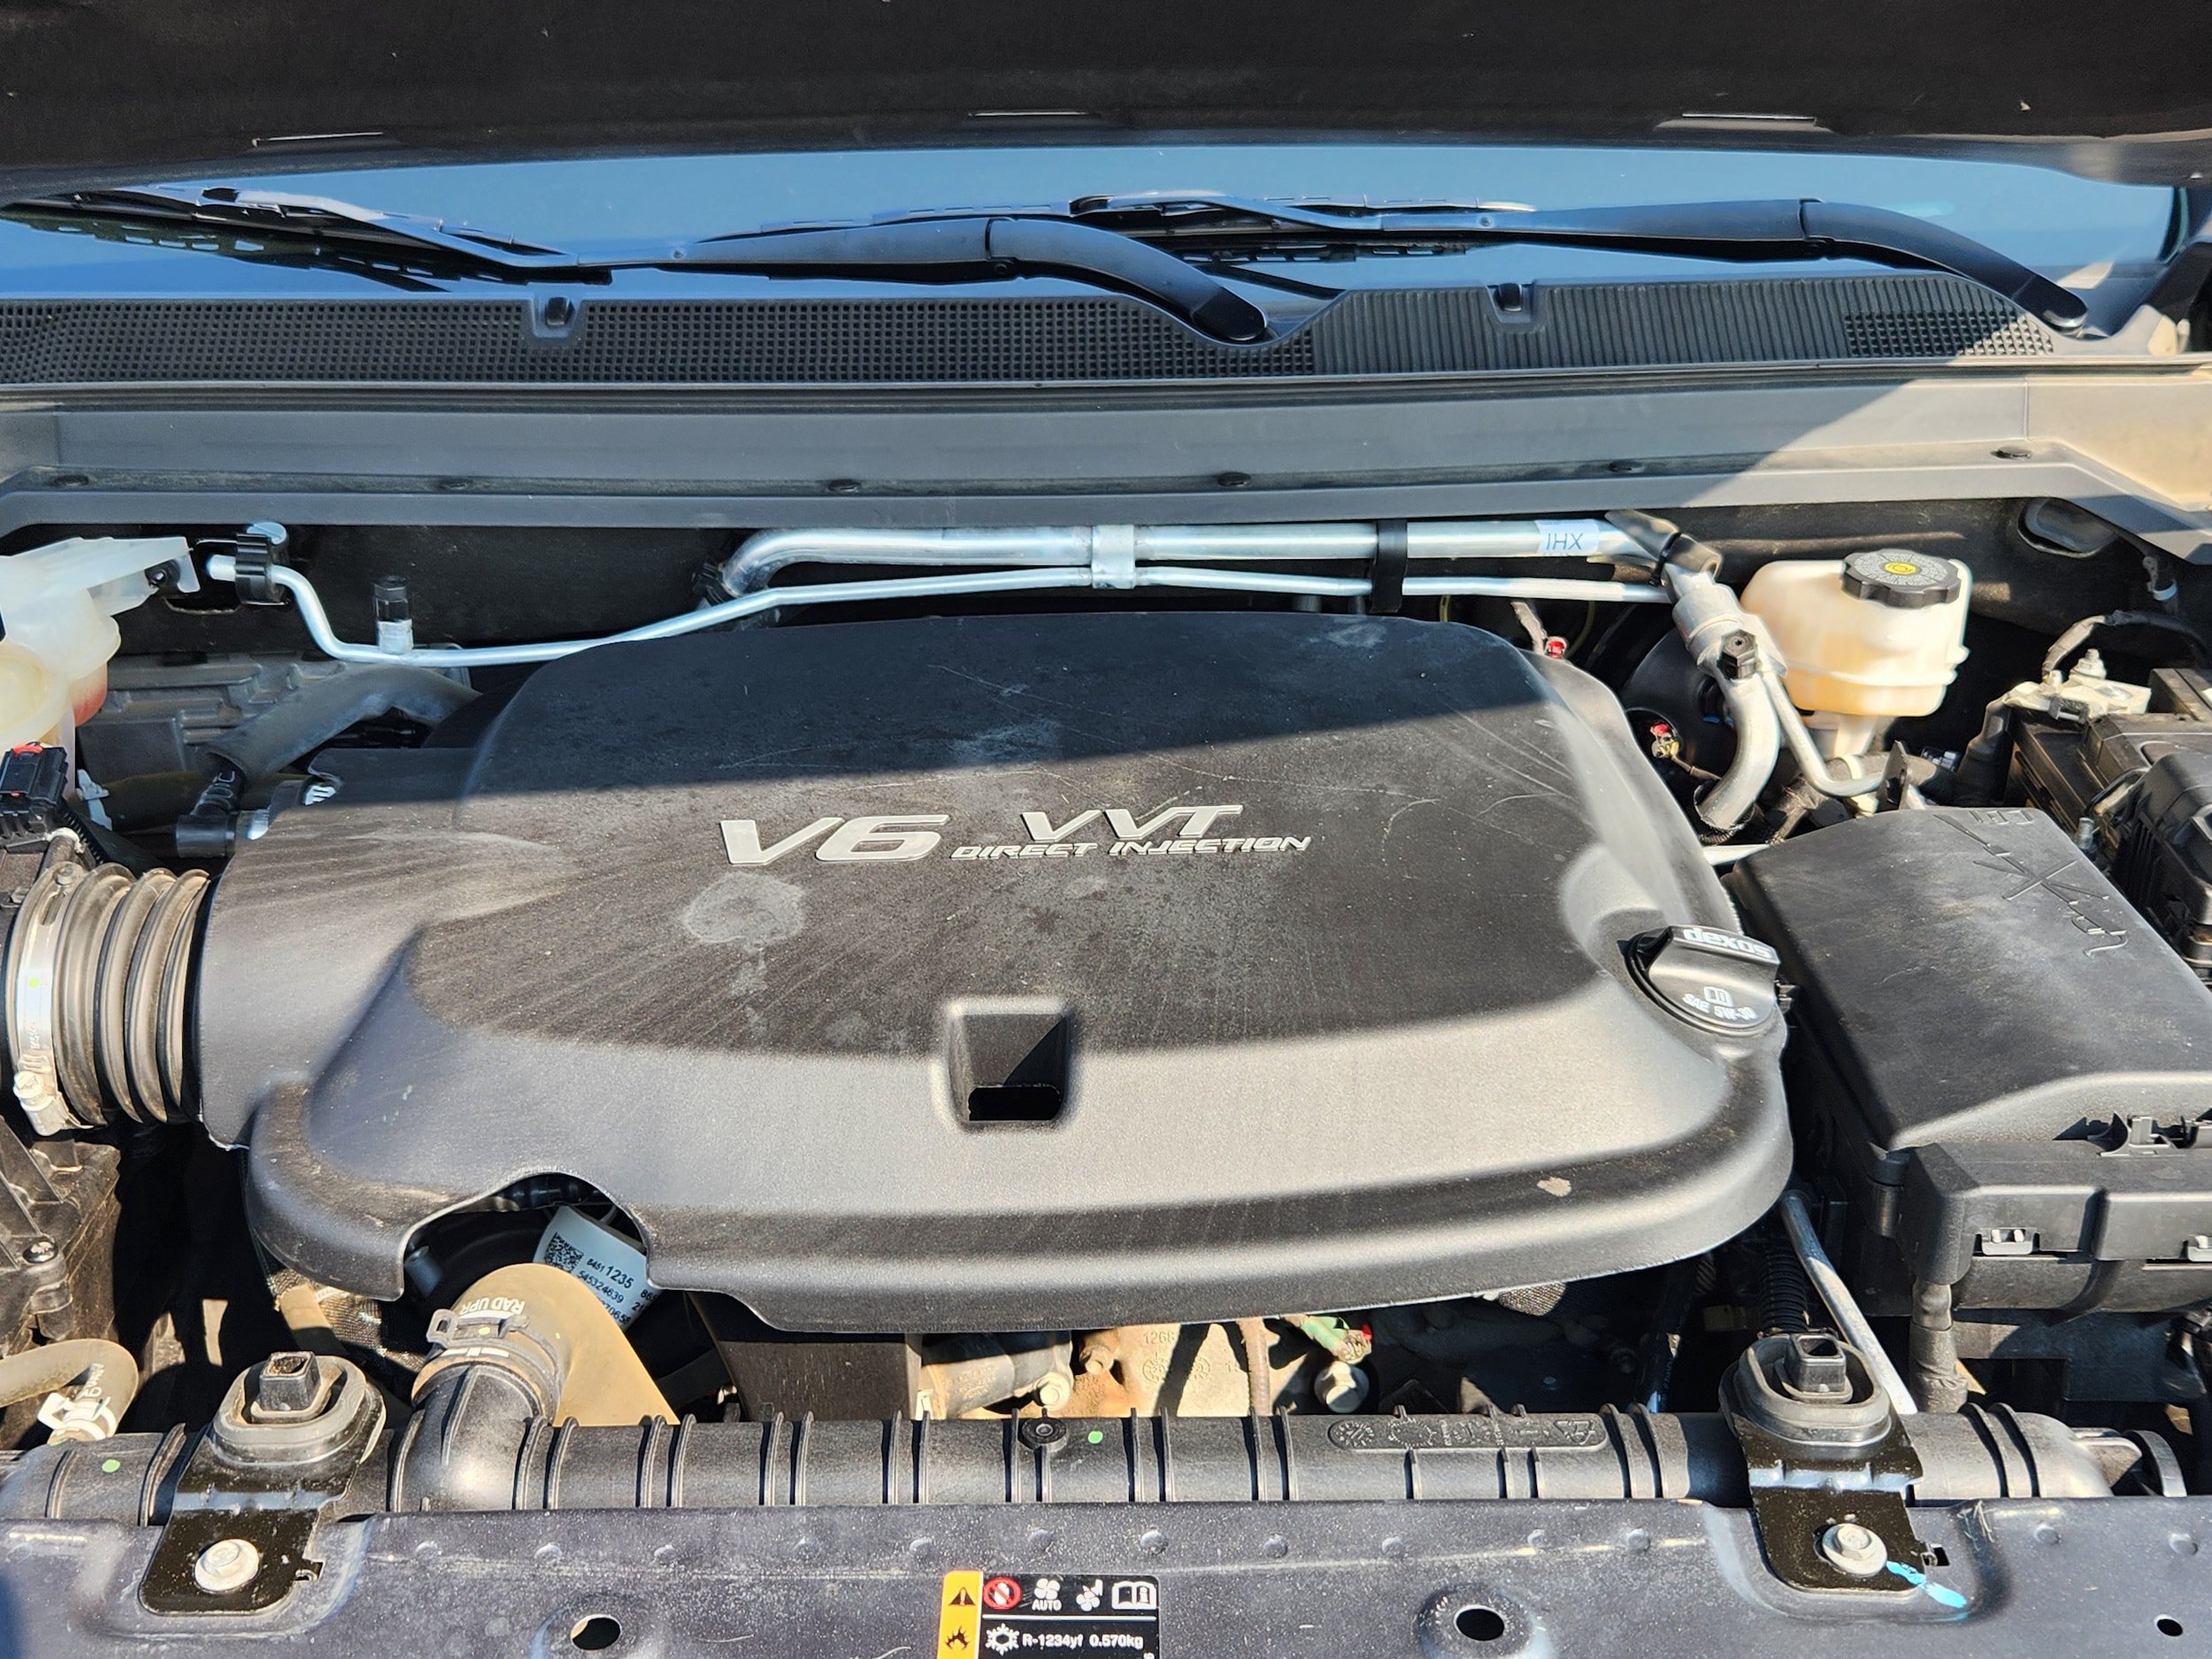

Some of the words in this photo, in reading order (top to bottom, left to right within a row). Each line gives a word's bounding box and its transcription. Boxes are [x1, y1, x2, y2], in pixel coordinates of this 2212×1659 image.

[1546, 533, 1584, 550] IHX
[1022, 804, 1243, 841] VVT
[720, 813, 951, 865] V6
[950, 841, 1099, 861] DIRECT
[1108, 836, 1312, 857] INJECTION
[1683, 928, 1771, 959] dexos
[1682, 993, 1712, 1014] SAE
[459, 1296, 490, 1316] UPR
[491, 1296, 526, 1315] RAD
[1032, 1599, 1063, 1611] AUTO
[1022, 1633, 1083, 1649] R-1234yf
[1089, 1633, 1144, 1650] 0.570kg
